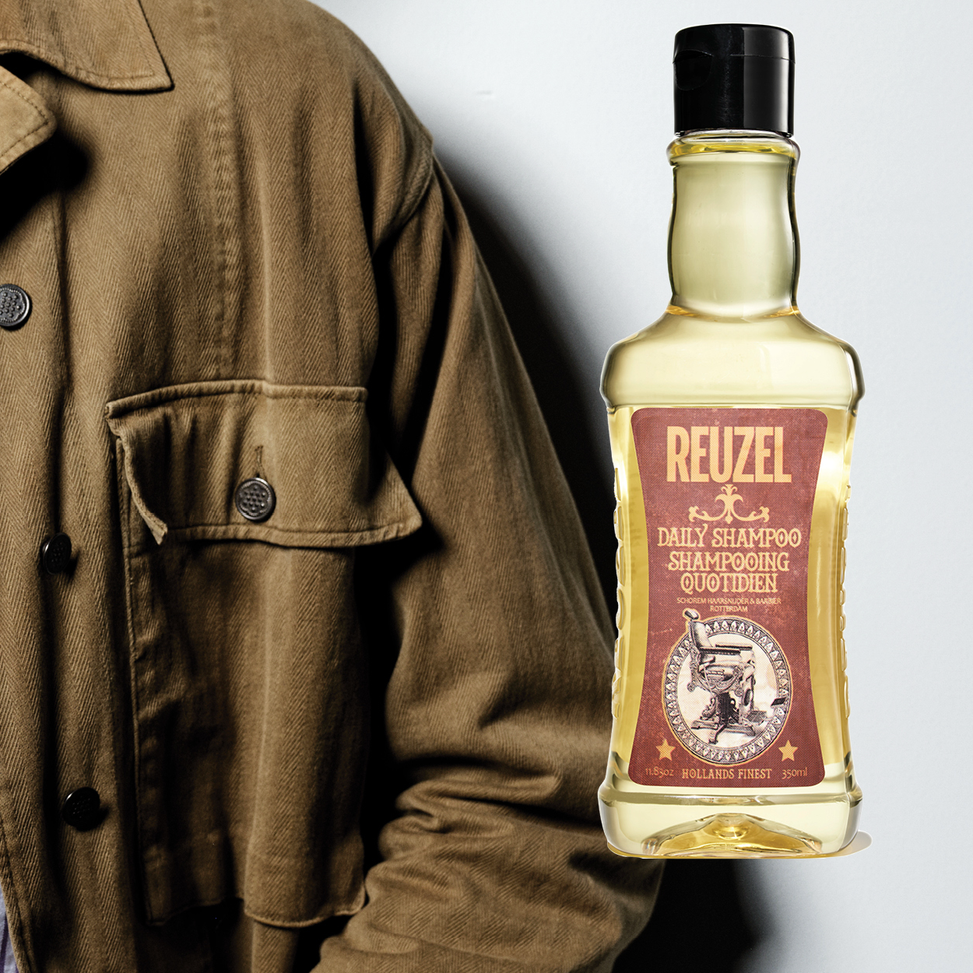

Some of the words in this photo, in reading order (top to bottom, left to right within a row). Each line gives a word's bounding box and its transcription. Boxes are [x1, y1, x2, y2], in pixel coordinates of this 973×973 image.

[666, 425, 793, 483] REUZEL
[657, 523, 709, 547] DAILY
[711, 527, 803, 548] SHAMPOO
[667, 550, 790, 572] SHAMPOOING
[679, 572, 779, 595] QUOTIDIEN
[676, 596, 707, 604] SCHOREM
[681, 768, 735, 779] HOLLANDS
[737, 768, 773, 780] FINEST
[781, 766, 808, 780] 350ml
